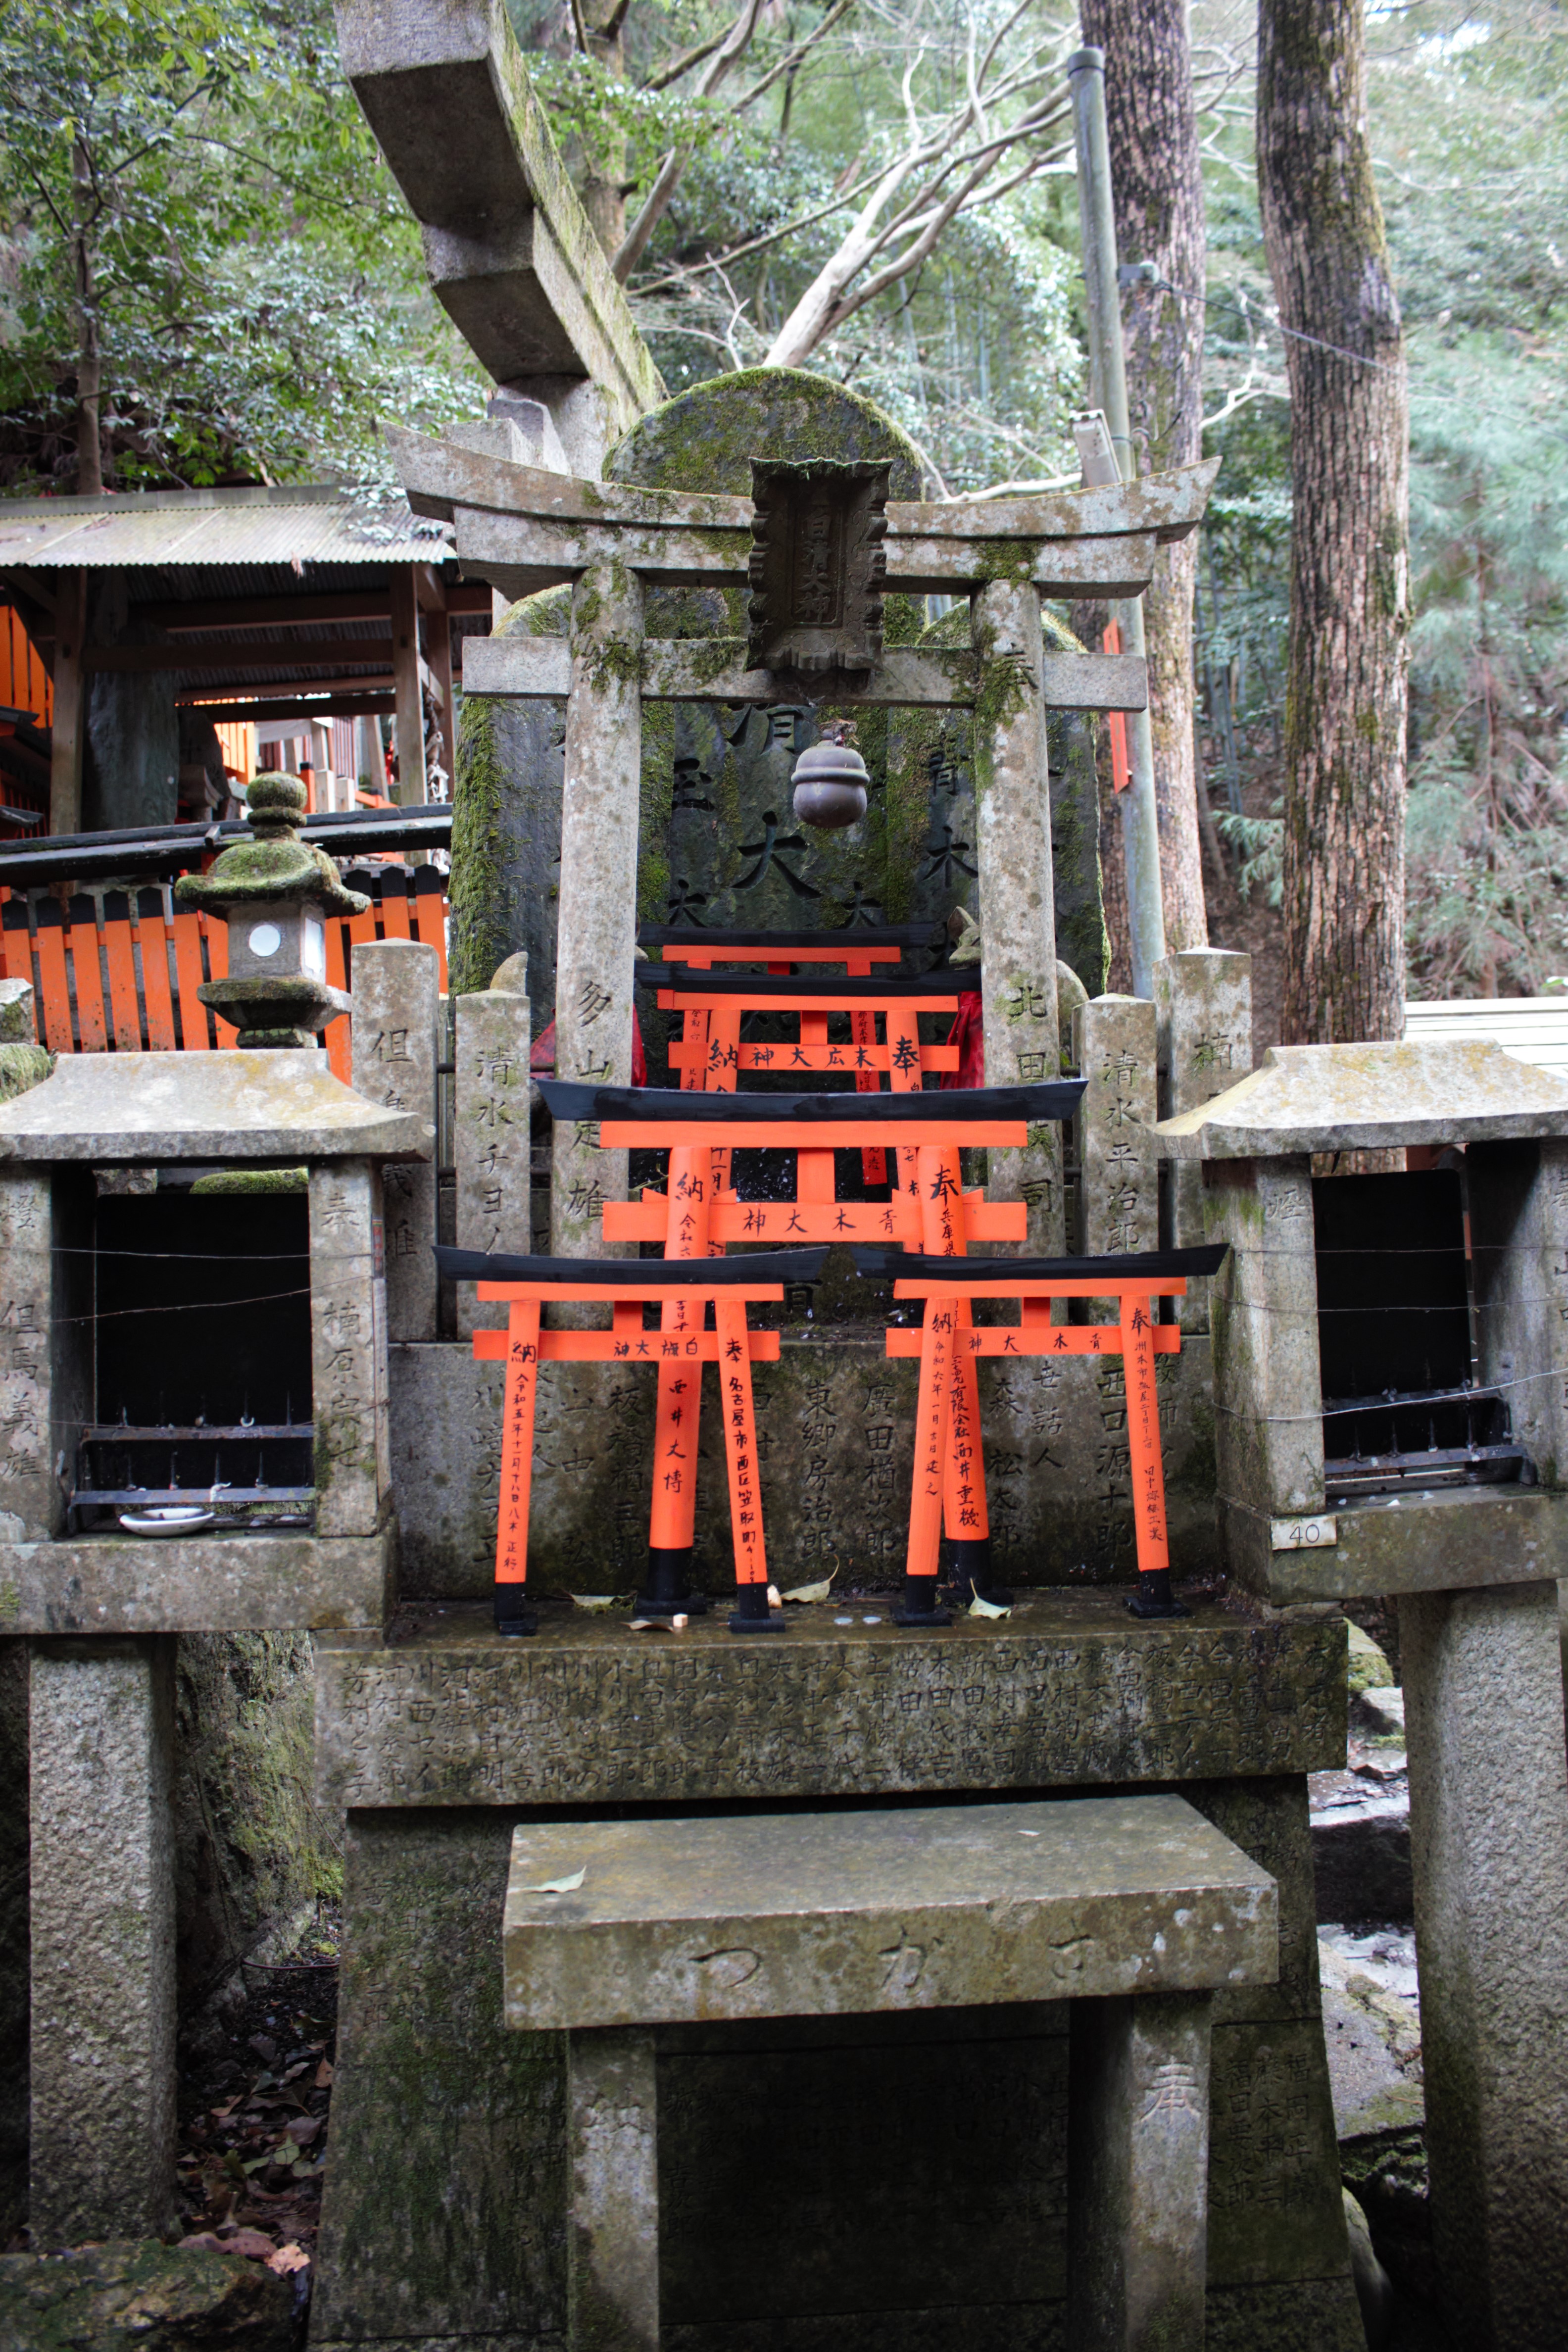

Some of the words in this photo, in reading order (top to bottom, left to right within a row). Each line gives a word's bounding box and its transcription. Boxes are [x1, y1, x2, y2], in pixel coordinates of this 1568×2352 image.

[708, 1038, 738, 1073] 納
[892, 1035, 921, 1079] 奉
[1103, 1049, 1141, 1252] 清水平治郎
[675, 1172, 703, 1203] 納
[930, 1164, 959, 1208] 奉
[321, 1192, 360, 1227] 奉
[940, 1209, 957, 1256] 兵庫県
[932, 1313, 951, 1334] 納
[1130, 1308, 1152, 1332] 奉
[511, 1342, 537, 1364] 納
[726, 1338, 743, 1363] 奉
[1031, 1360, 1064, 1468] 世話人
[1289, 1524, 1320, 1544] 40
